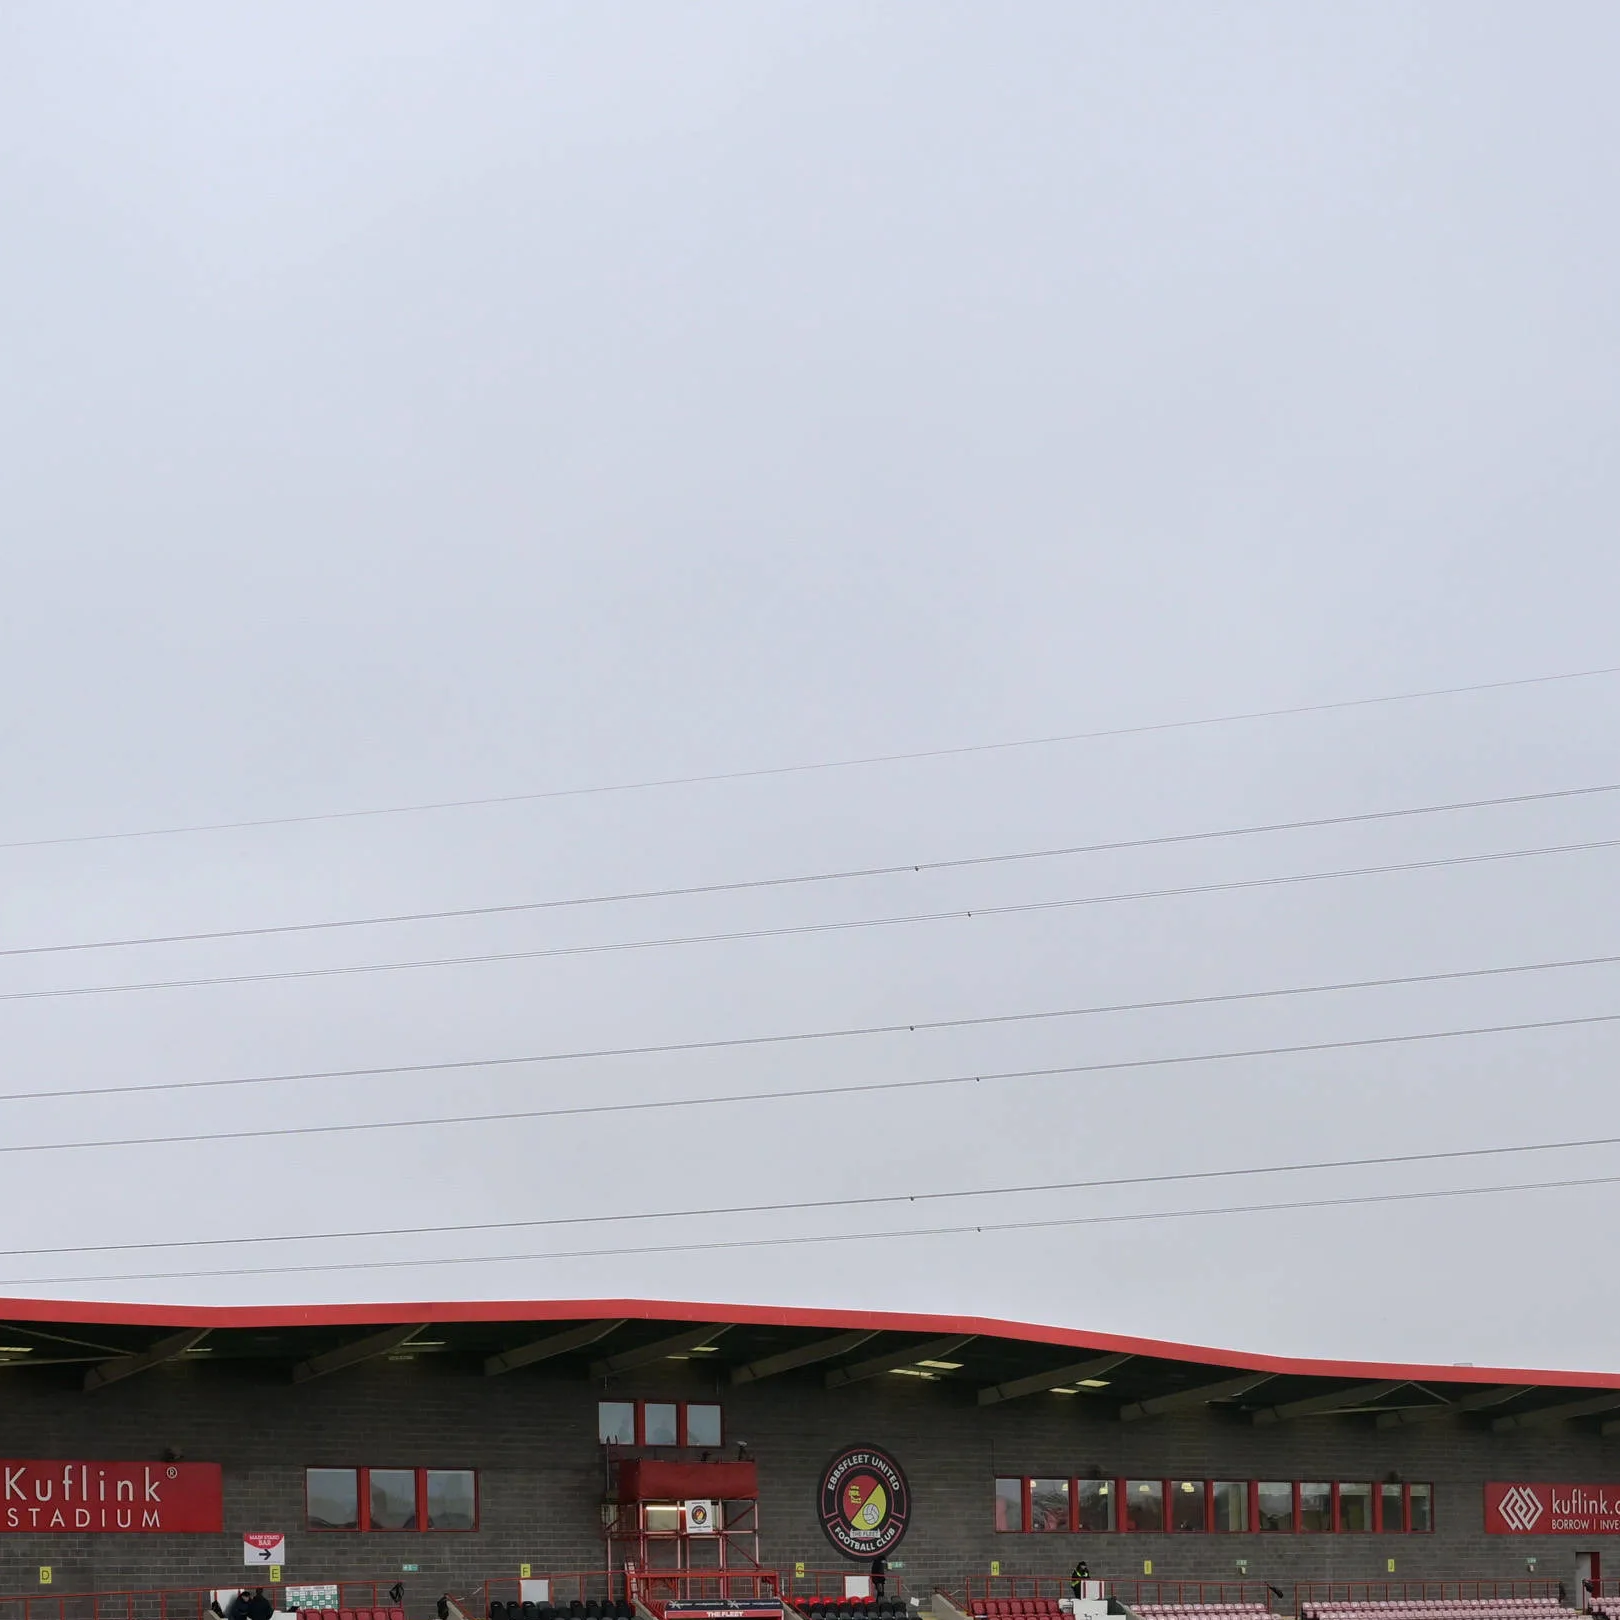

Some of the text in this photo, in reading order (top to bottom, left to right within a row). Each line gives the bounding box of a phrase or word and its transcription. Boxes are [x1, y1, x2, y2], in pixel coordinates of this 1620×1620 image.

[827, 1454, 900, 1491] EBBSFLEET UNITED
[7, 1507, 161, 1528] STADIUM
[1551, 1519, 1590, 1530] BORROW
[834, 1526, 896, 1552] FOOTBALL CLUB
[41, 1570, 50, 1581] D
[271, 1568, 279, 1579] E
[522, 1567, 529, 1577] F
